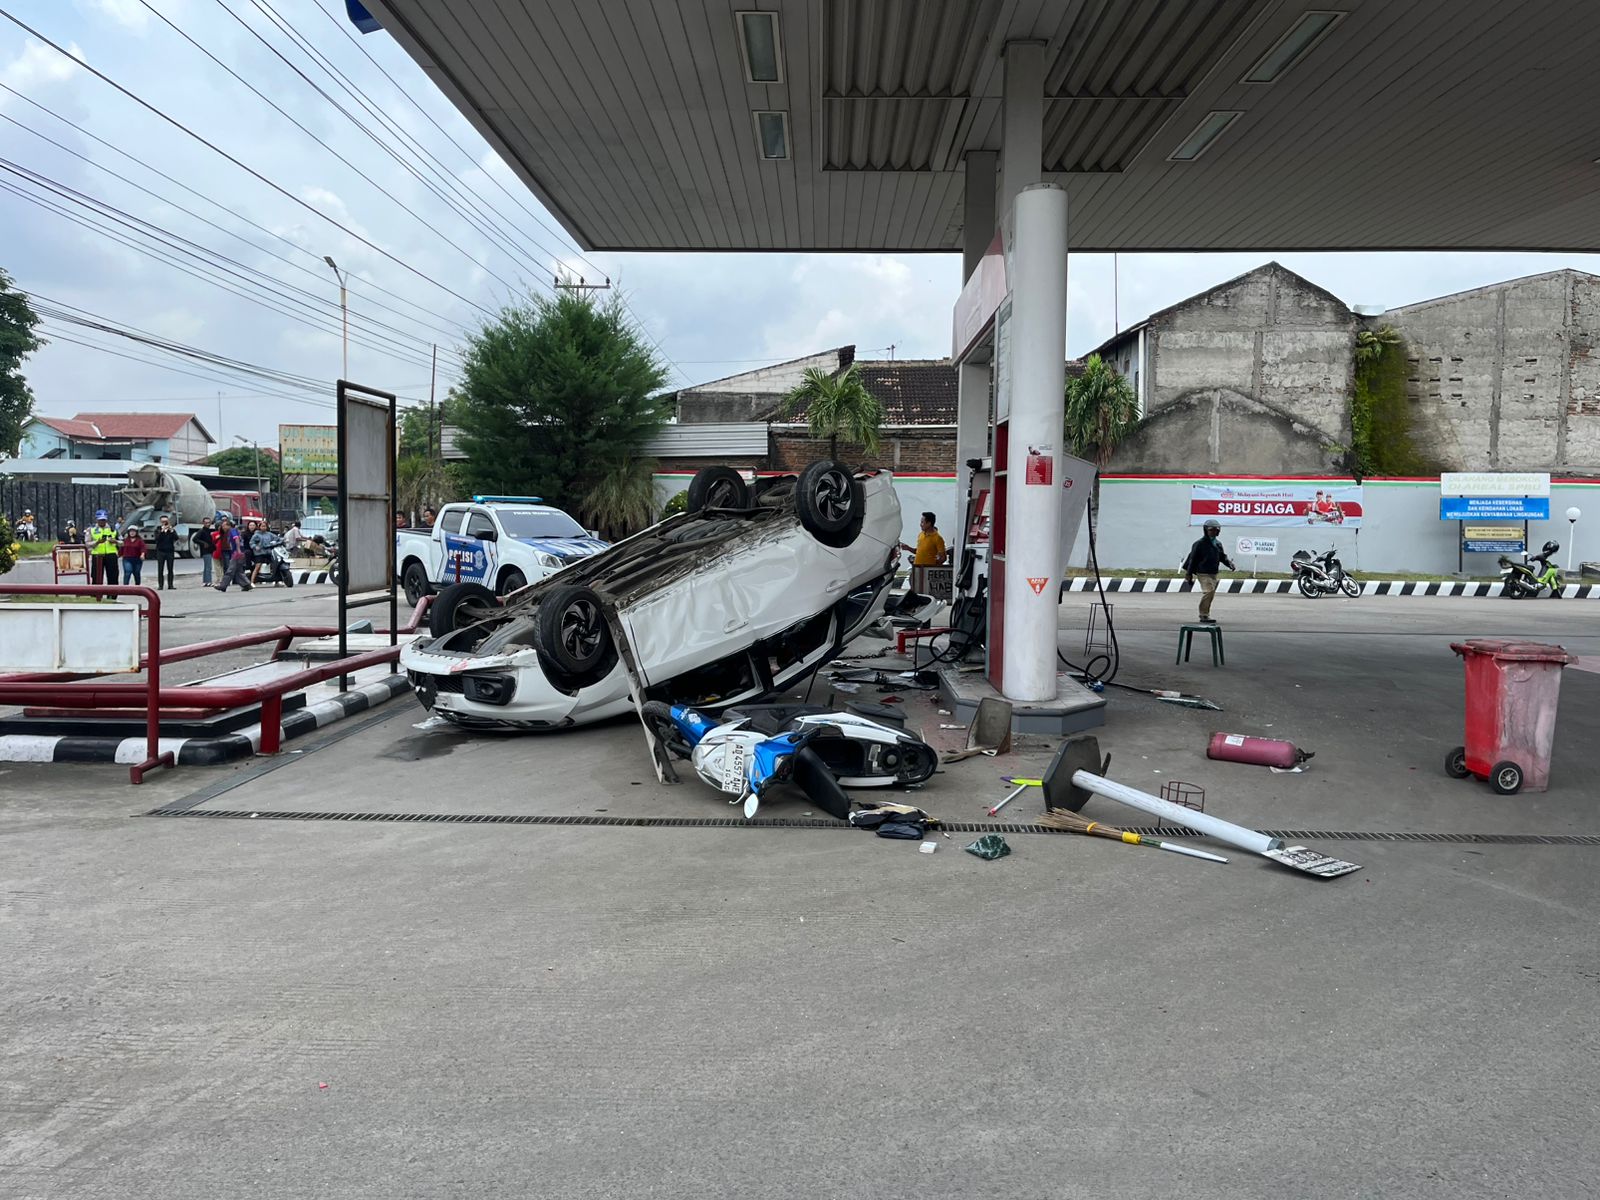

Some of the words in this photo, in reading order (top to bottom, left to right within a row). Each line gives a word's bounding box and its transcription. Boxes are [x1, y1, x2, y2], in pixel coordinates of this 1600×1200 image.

[1218, 502, 1251, 514] SPBU
[1254, 503, 1295, 514] SIAGA
[448, 549, 473, 564] POLISI
